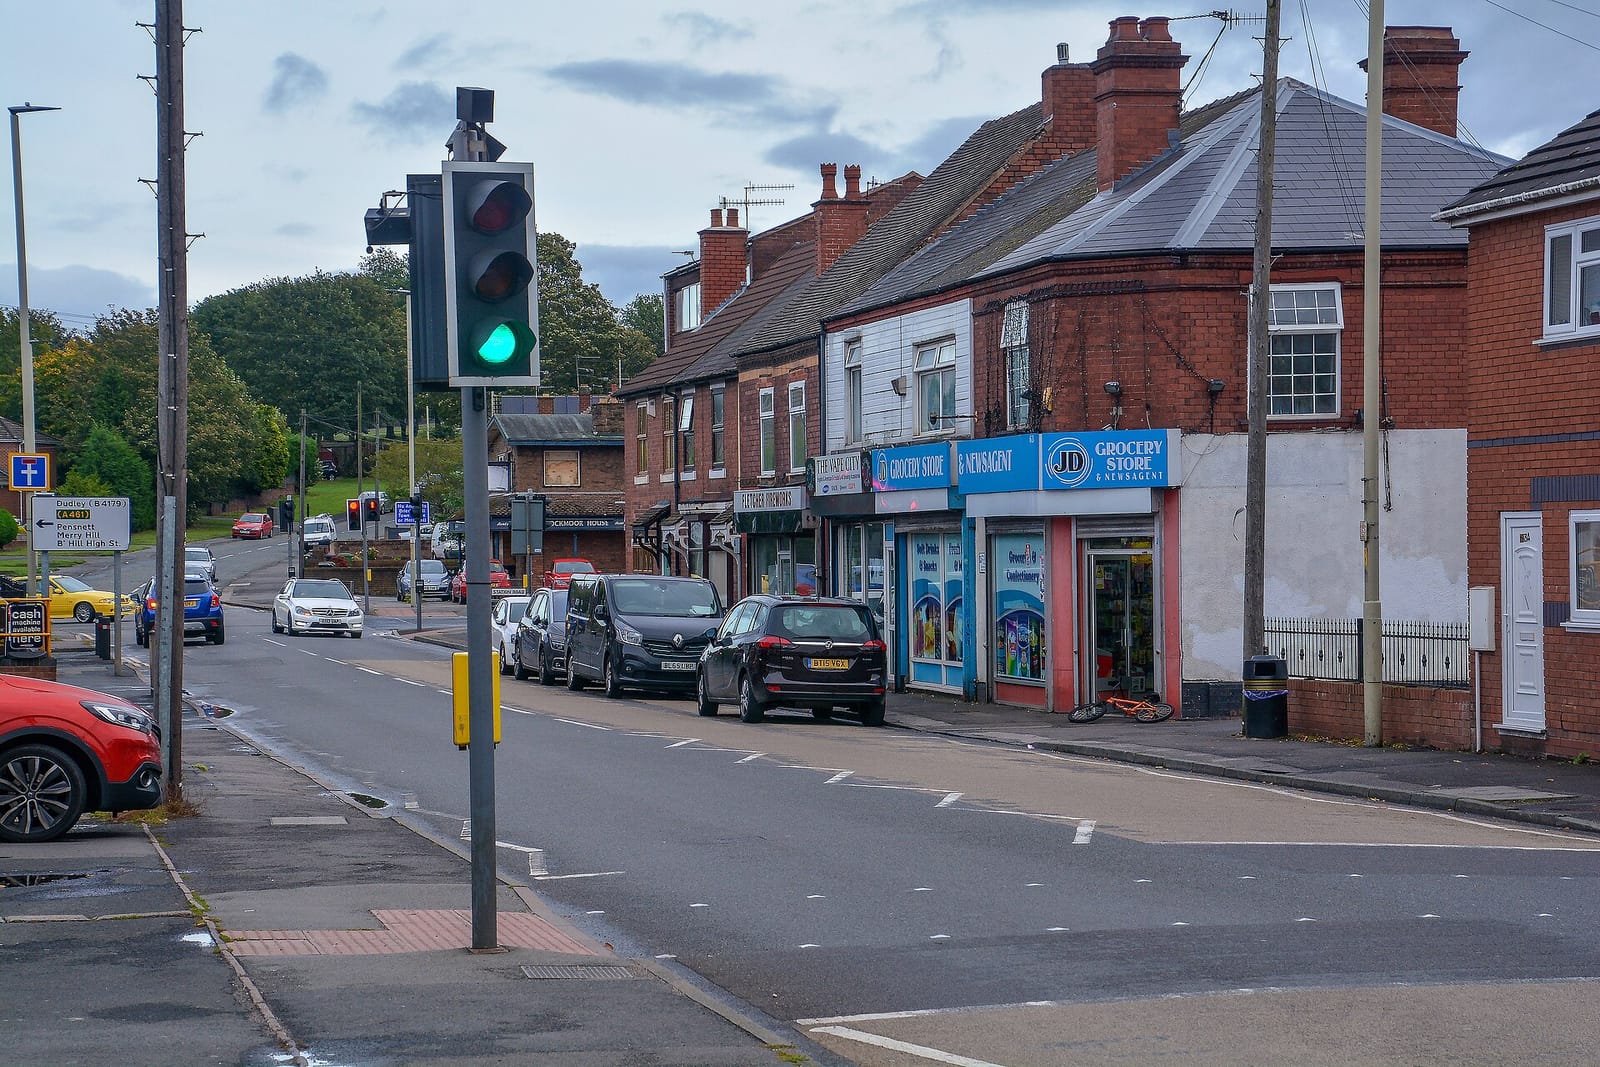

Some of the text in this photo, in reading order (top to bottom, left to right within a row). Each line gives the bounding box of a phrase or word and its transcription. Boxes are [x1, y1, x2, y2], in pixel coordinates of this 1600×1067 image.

[1094, 440, 1163, 456] GROCERY
[817, 455, 860, 474] THE VAPE CITY
[890, 455, 944, 479] GROCERY STORE
[958, 449, 1012, 475] & NEWSAGENT
[1053, 450, 1084, 474] JD
[1106, 456, 1152, 471] STORE
[1096, 471, 1163, 481] & NEWSAGENT
[57, 500, 85, 508] Dudley
[742, 490, 792, 508] FLETCHER FIREWORKS
[57, 510, 89, 519] (A461)
[57, 532, 82, 540] Merry
[86, 540, 106, 548] High
[12, 608, 41, 619] cash
